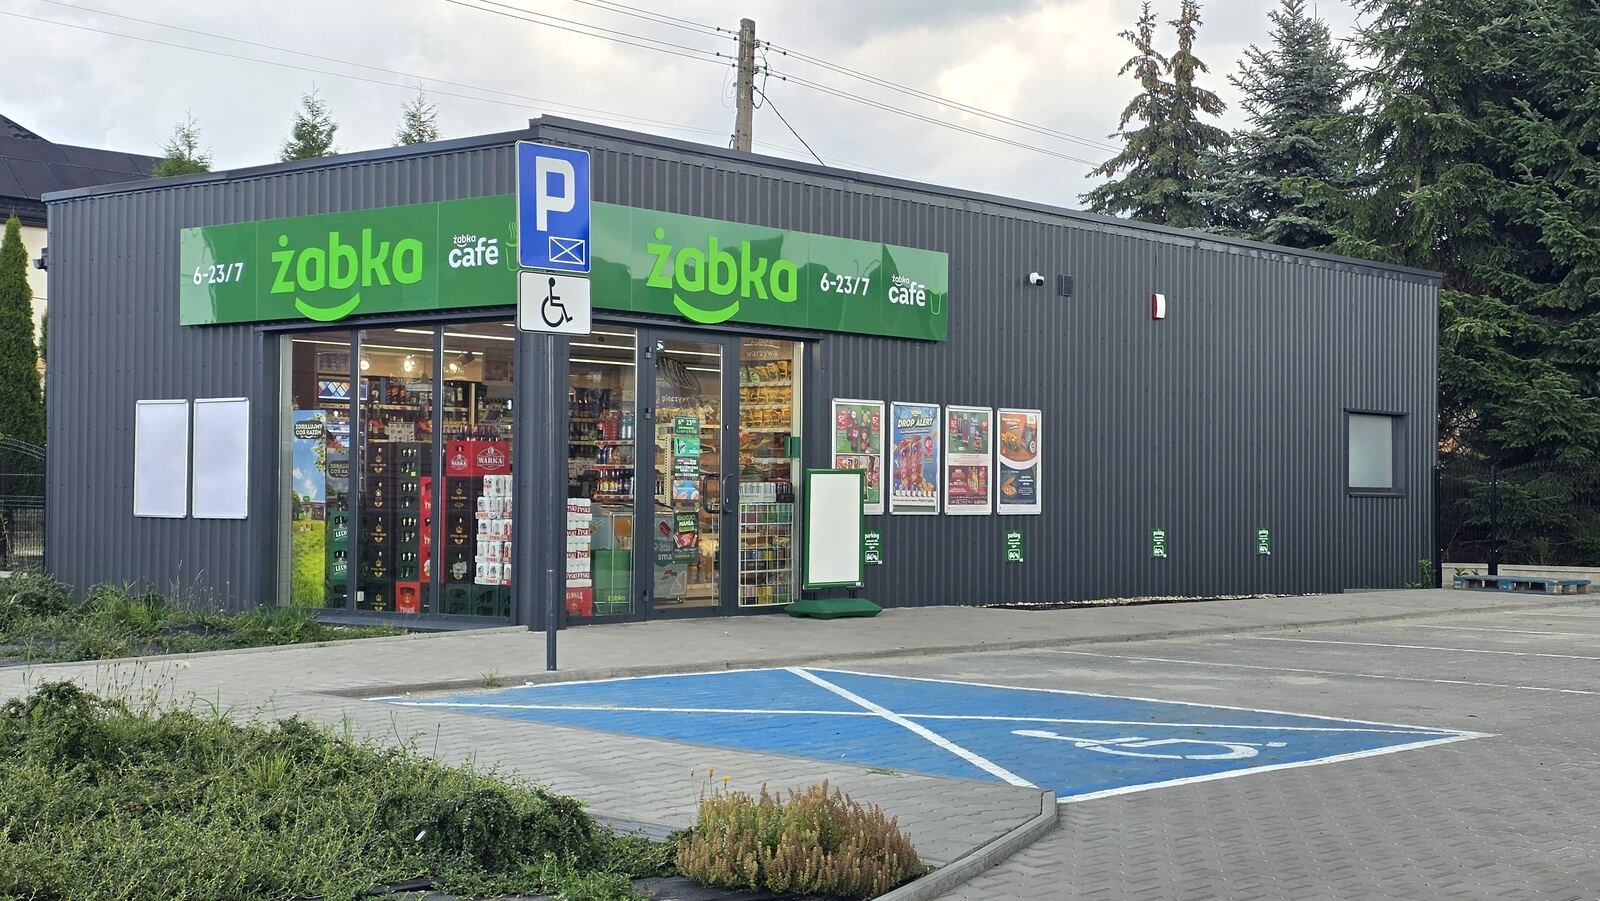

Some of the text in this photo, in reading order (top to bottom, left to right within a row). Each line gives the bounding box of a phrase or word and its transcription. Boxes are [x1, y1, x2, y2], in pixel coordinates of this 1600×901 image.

[535, 155, 575, 231] P
[453, 234, 476, 244] żabka
[270, 228, 423, 294] żabka
[448, 237, 499, 268] café
[193, 262, 244, 285] 6-23/7
[645, 227, 798, 303] żabka
[820, 272, 870, 296] 6-23/7
[888, 281, 926, 307] café
[897, 417, 934, 428] DROP ALERT
[335, 530, 348, 538] LECH
[335, 564, 348, 572] LECH
